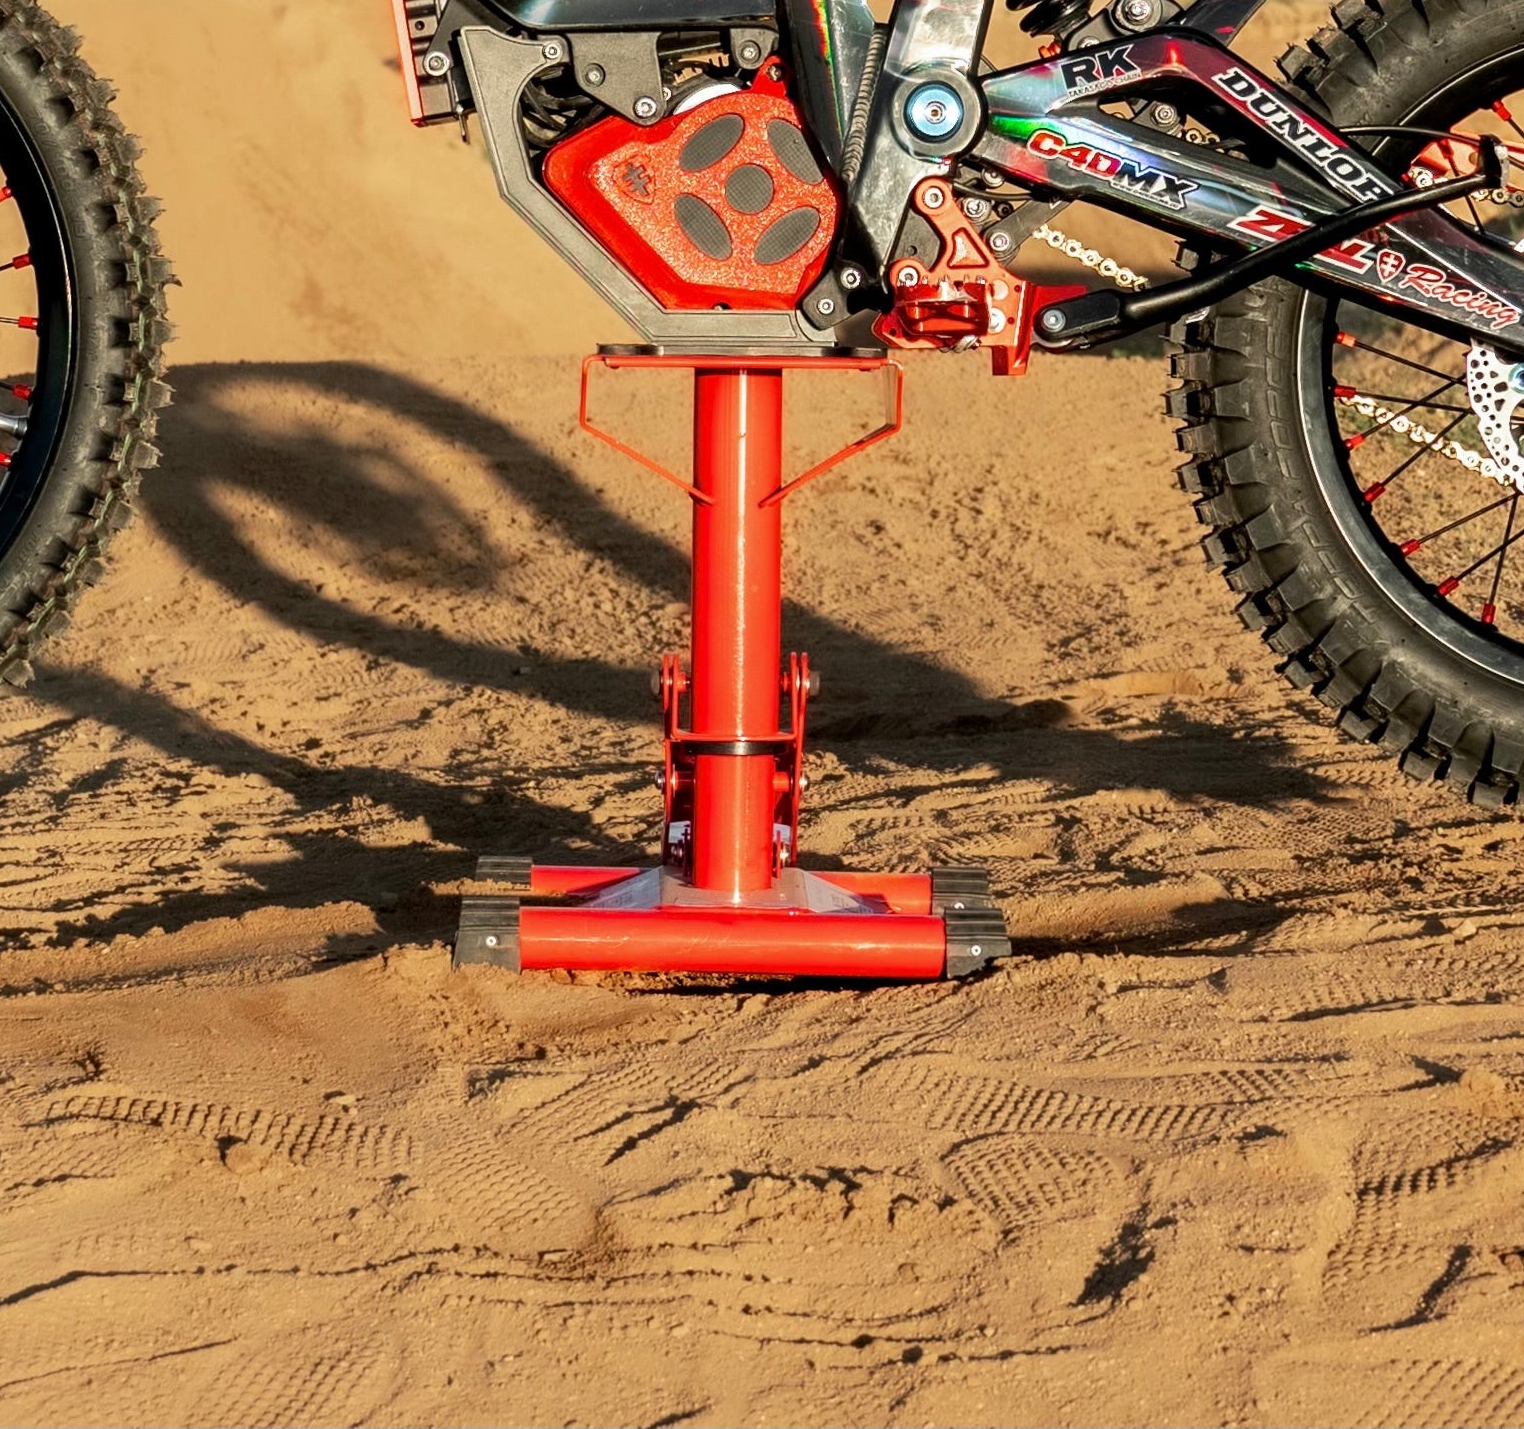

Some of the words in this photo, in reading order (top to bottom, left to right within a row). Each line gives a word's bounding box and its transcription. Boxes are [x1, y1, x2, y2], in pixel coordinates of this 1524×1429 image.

[1060, 45, 1140, 91] RK
[1027, 130, 1201, 209] C4DMX
[1212, 67, 1394, 205] DUNLOP
[1398, 262, 1523, 331] Racing
